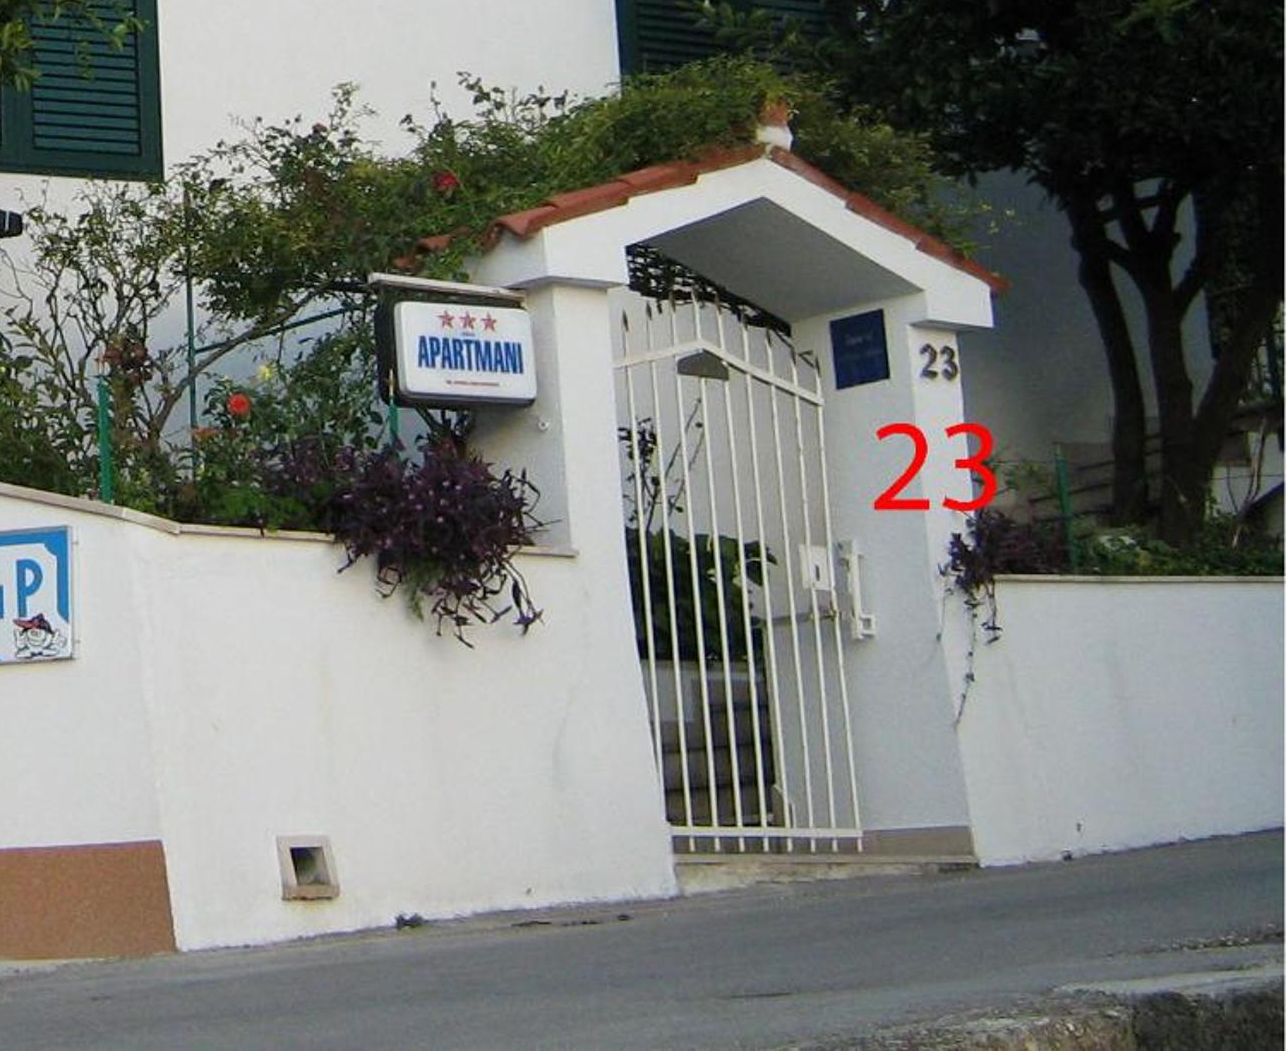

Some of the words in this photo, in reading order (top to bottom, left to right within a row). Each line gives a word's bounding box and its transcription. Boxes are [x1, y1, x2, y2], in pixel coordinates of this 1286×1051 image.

[417, 335, 523, 374] APARTMANI
[919, 343, 959, 381] 23
[16, 559, 43, 617] P
